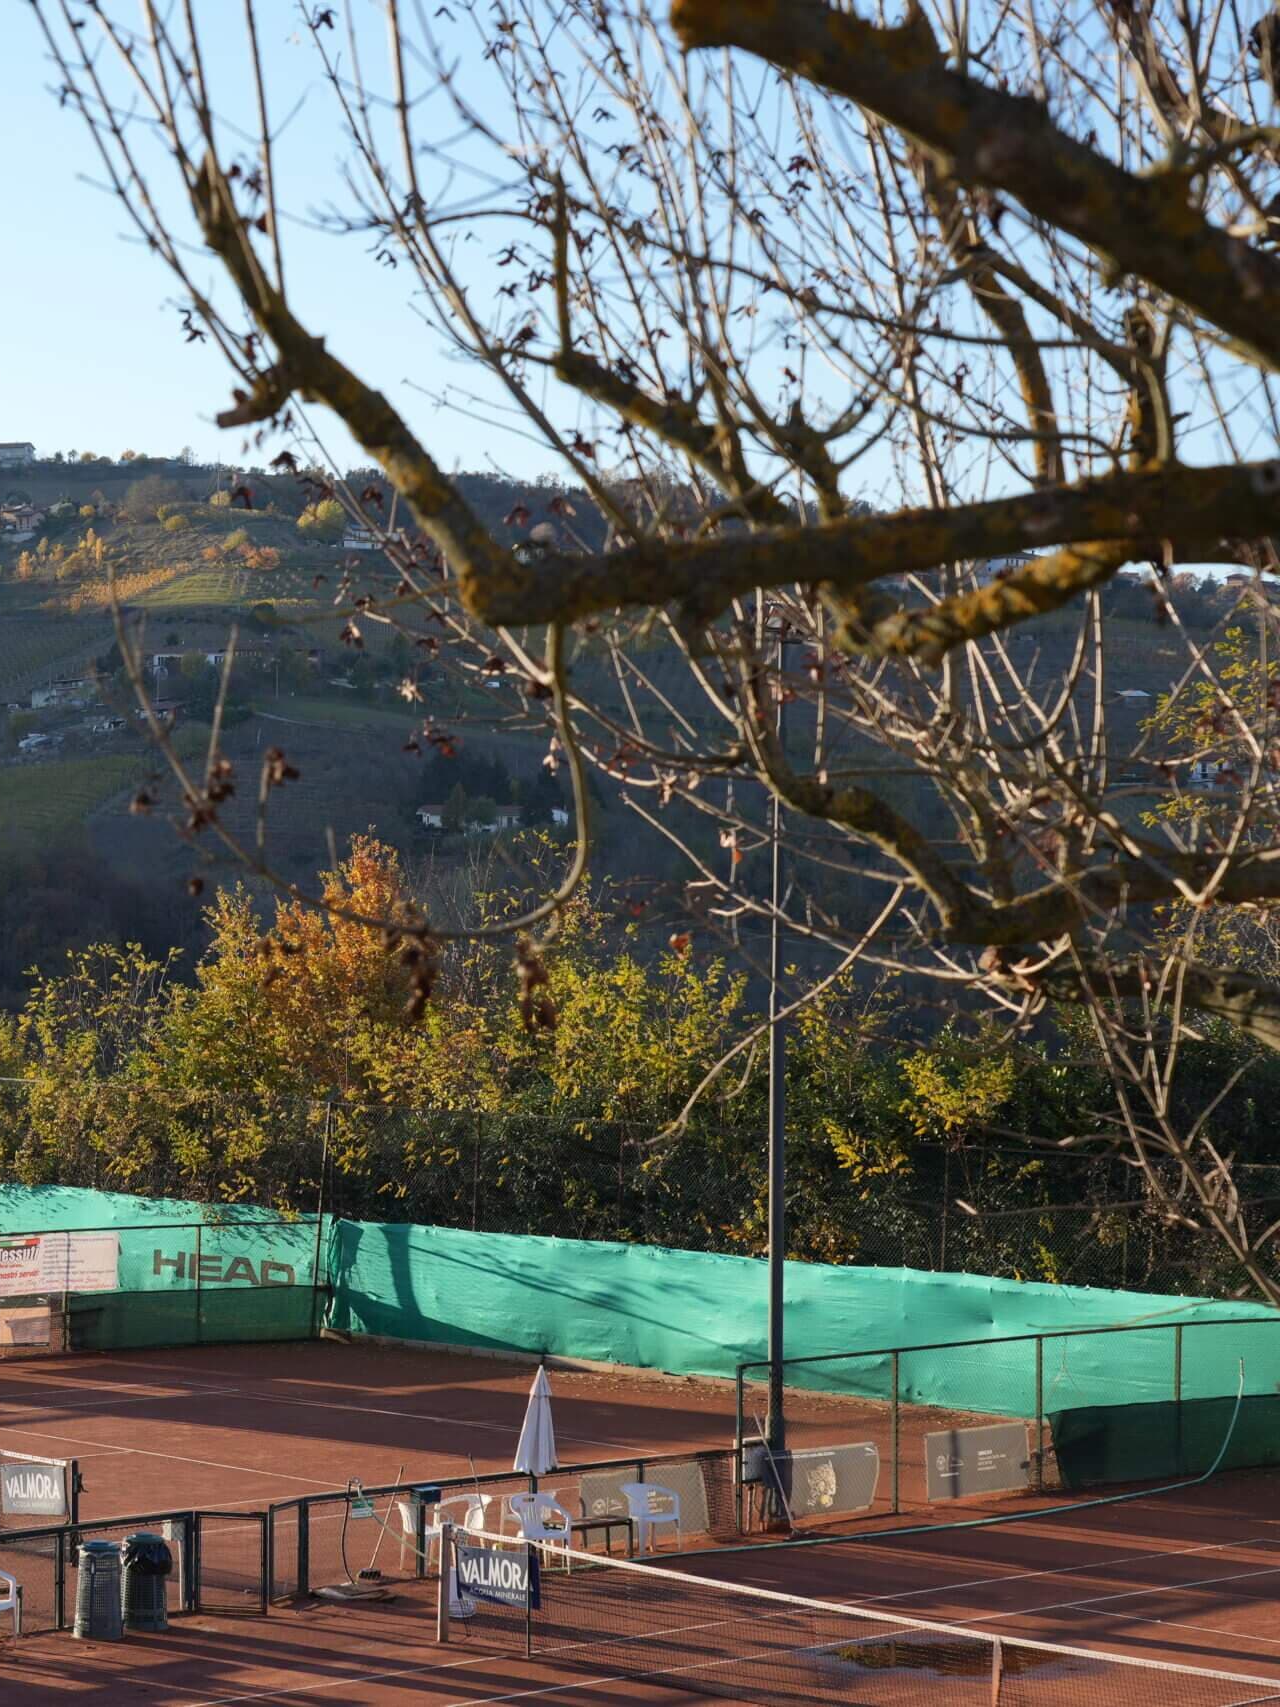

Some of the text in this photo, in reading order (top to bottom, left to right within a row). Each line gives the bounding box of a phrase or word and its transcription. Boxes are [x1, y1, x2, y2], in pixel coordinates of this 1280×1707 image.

[153, 1248, 296, 1287] HEAD
[5, 1472, 61, 1500] VALMORA
[460, 1556, 534, 1593] VALMORA
